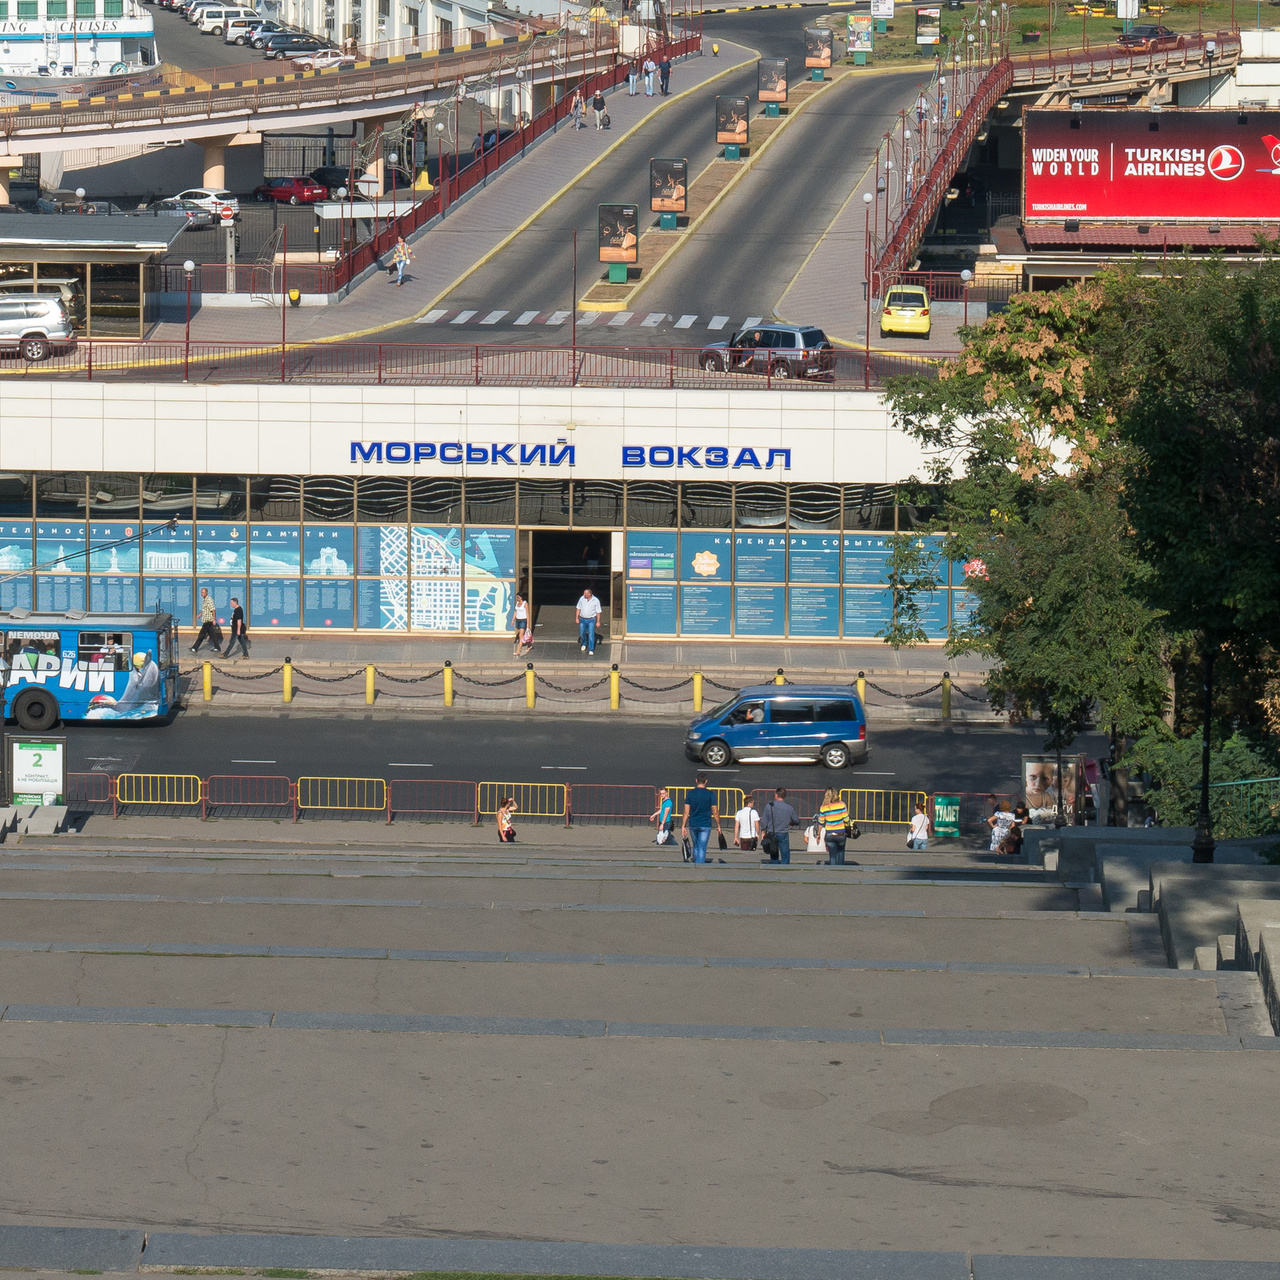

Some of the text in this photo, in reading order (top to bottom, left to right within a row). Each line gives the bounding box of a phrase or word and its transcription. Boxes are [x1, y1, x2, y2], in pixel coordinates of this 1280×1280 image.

[60, 20, 118, 32] CRUISES
[1032, 148, 1099, 162] WIDEN YOUR
[1125, 148, 1205, 162] TURKISH
[1032, 162, 1099, 176] WORLD
[1124, 162, 1206, 176] AIRLINES
[1032, 203, 1087, 211] TURKISHAIRLINES.COM
[350, 439, 791, 469] МОРСЬКИЙ ВОКЗАЛ
[714, 538, 807, 546] КАЛЕНДАРЬ
[32, 753, 43, 767] 2
[935, 805, 960, 822] ТУАЛЕТ
